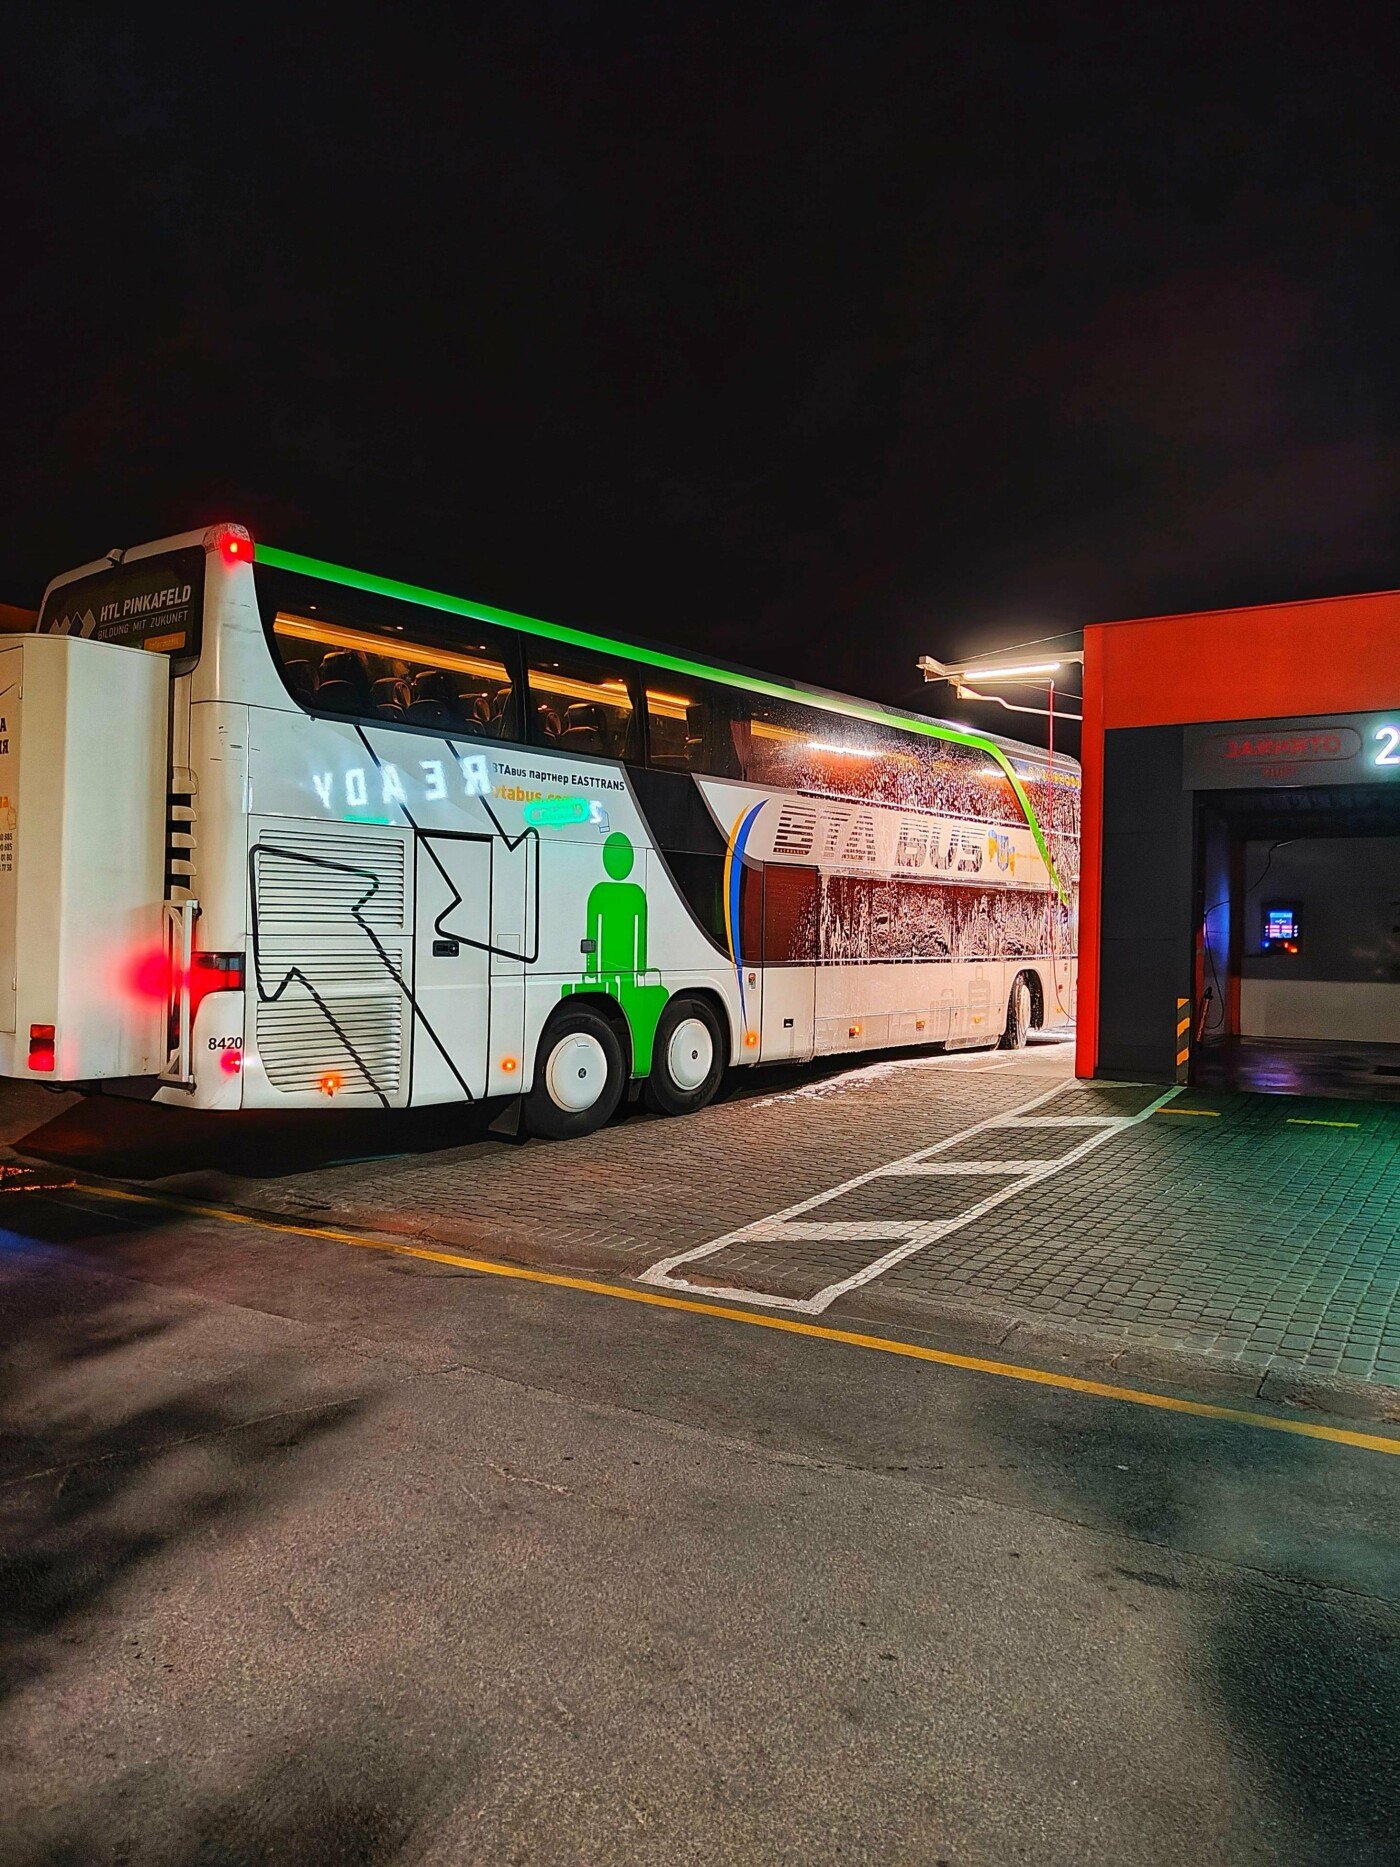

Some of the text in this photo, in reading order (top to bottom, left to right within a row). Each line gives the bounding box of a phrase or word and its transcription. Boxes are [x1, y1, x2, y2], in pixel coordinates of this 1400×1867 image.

[100, 585, 192, 622] HTL PINKAFELD
[97, 611, 189, 640] BILDUNG MIT ZUKUNFT
[1375, 727, 1399, 765] 2
[529, 770, 569, 786] партнер
[571, 774, 626, 791] EASTTRANS
[894, 817, 987, 872] BUS
[207, 1036, 243, 1051] 8420
